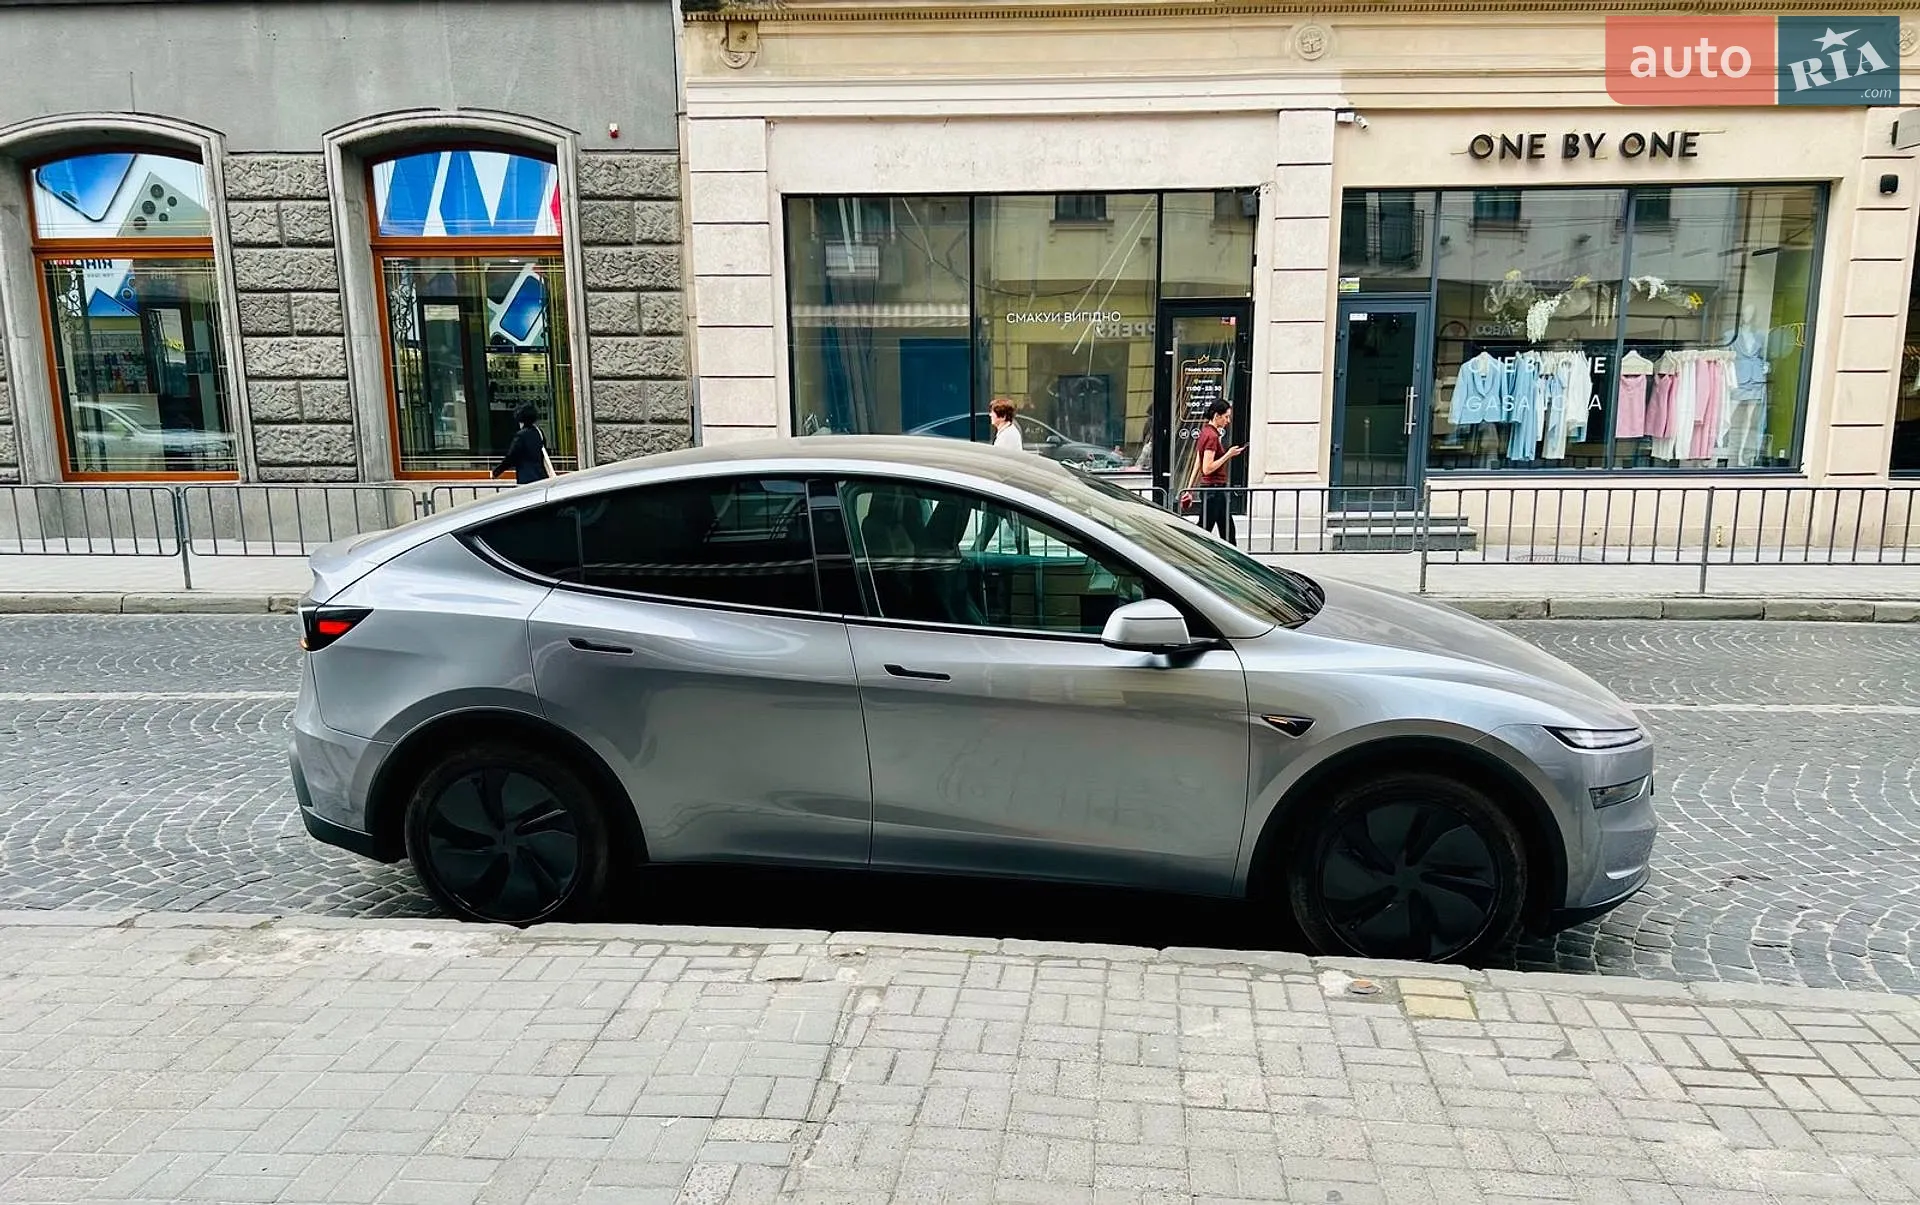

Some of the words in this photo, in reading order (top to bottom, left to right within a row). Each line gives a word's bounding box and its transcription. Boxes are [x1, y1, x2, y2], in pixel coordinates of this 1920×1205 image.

[1468, 133, 1547, 160] ONE
[1561, 133, 1606, 160] BY
[1618, 132, 1701, 159] ONE
